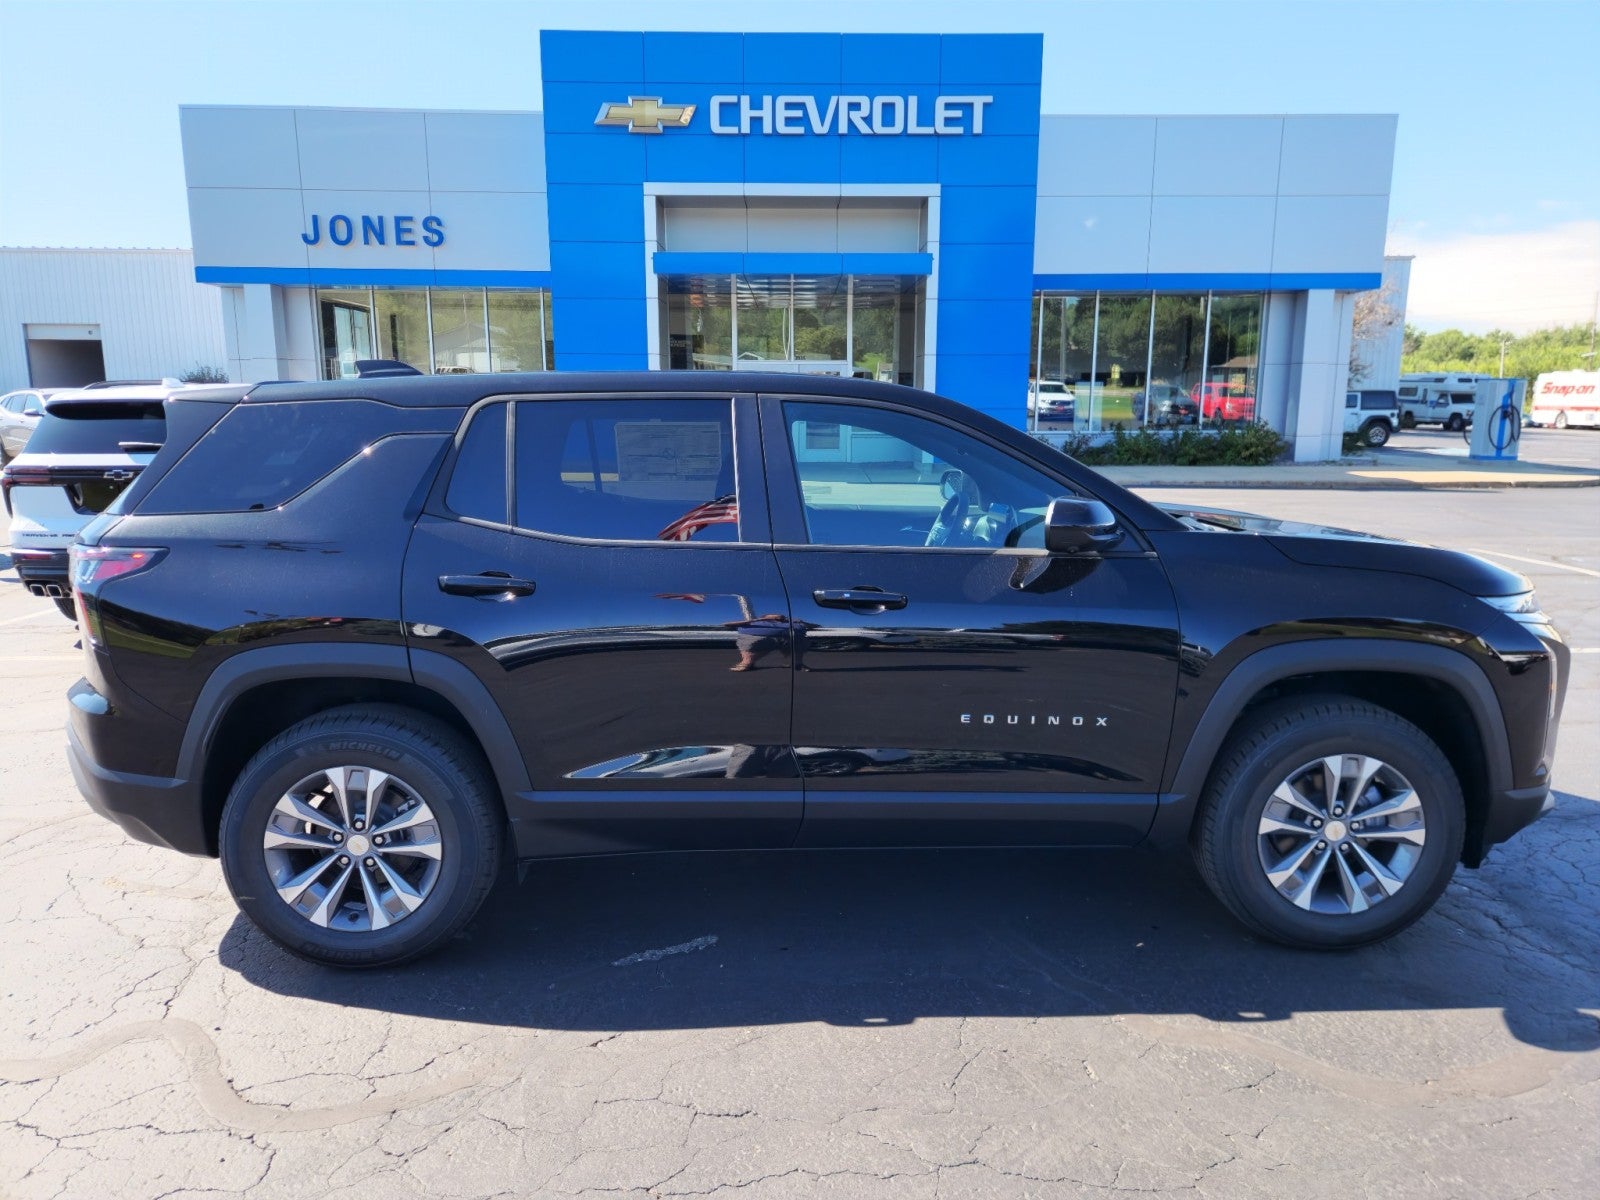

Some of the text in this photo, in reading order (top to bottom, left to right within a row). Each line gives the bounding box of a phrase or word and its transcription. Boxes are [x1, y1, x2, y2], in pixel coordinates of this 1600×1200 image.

[710, 95, 993, 135] CHEVROLET
[301, 214, 445, 247] JONES
[1541, 382, 1595, 397] Snap-on
[960, 714, 1107, 726] EQUINOX
[329, 741, 401, 760] MICHELIN
